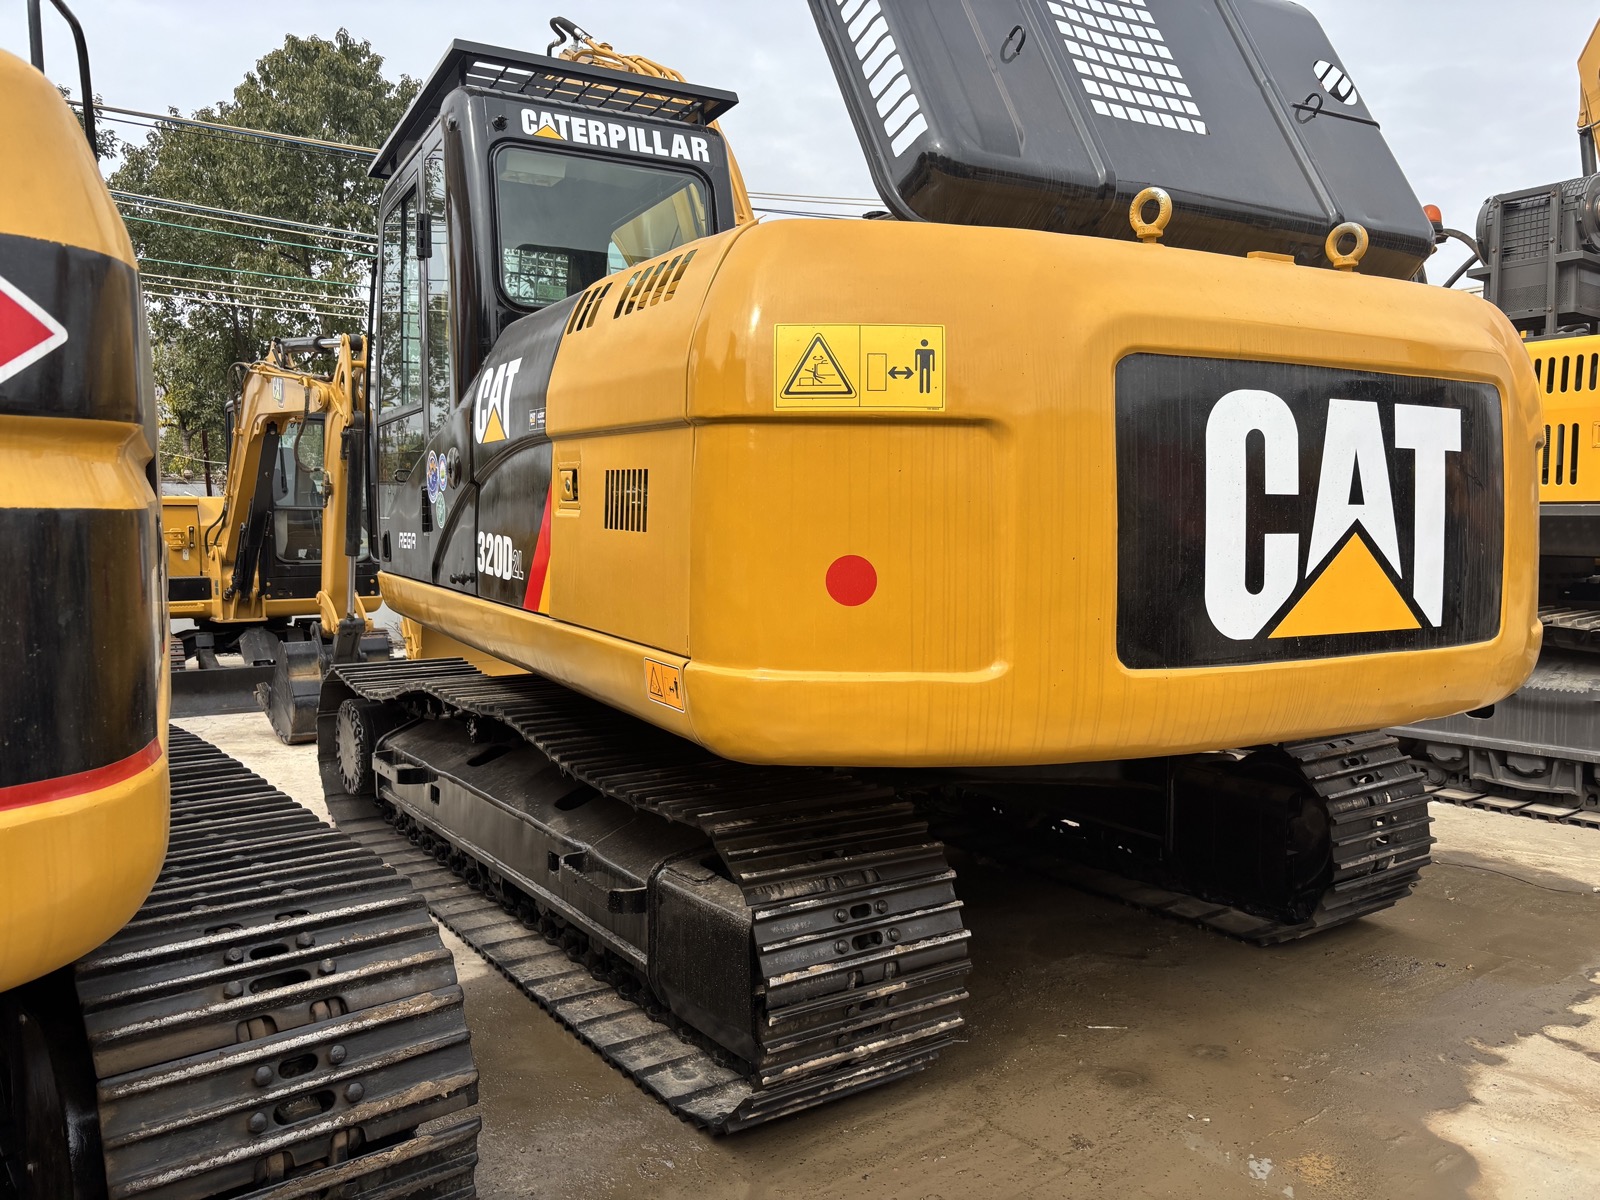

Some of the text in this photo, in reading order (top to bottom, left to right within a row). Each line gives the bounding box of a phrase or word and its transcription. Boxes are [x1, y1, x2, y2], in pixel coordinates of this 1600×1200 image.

[520, 108, 711, 163] CATERPILLAR
[475, 357, 522, 444] CAT
[1204, 389, 1462, 641] CAT
